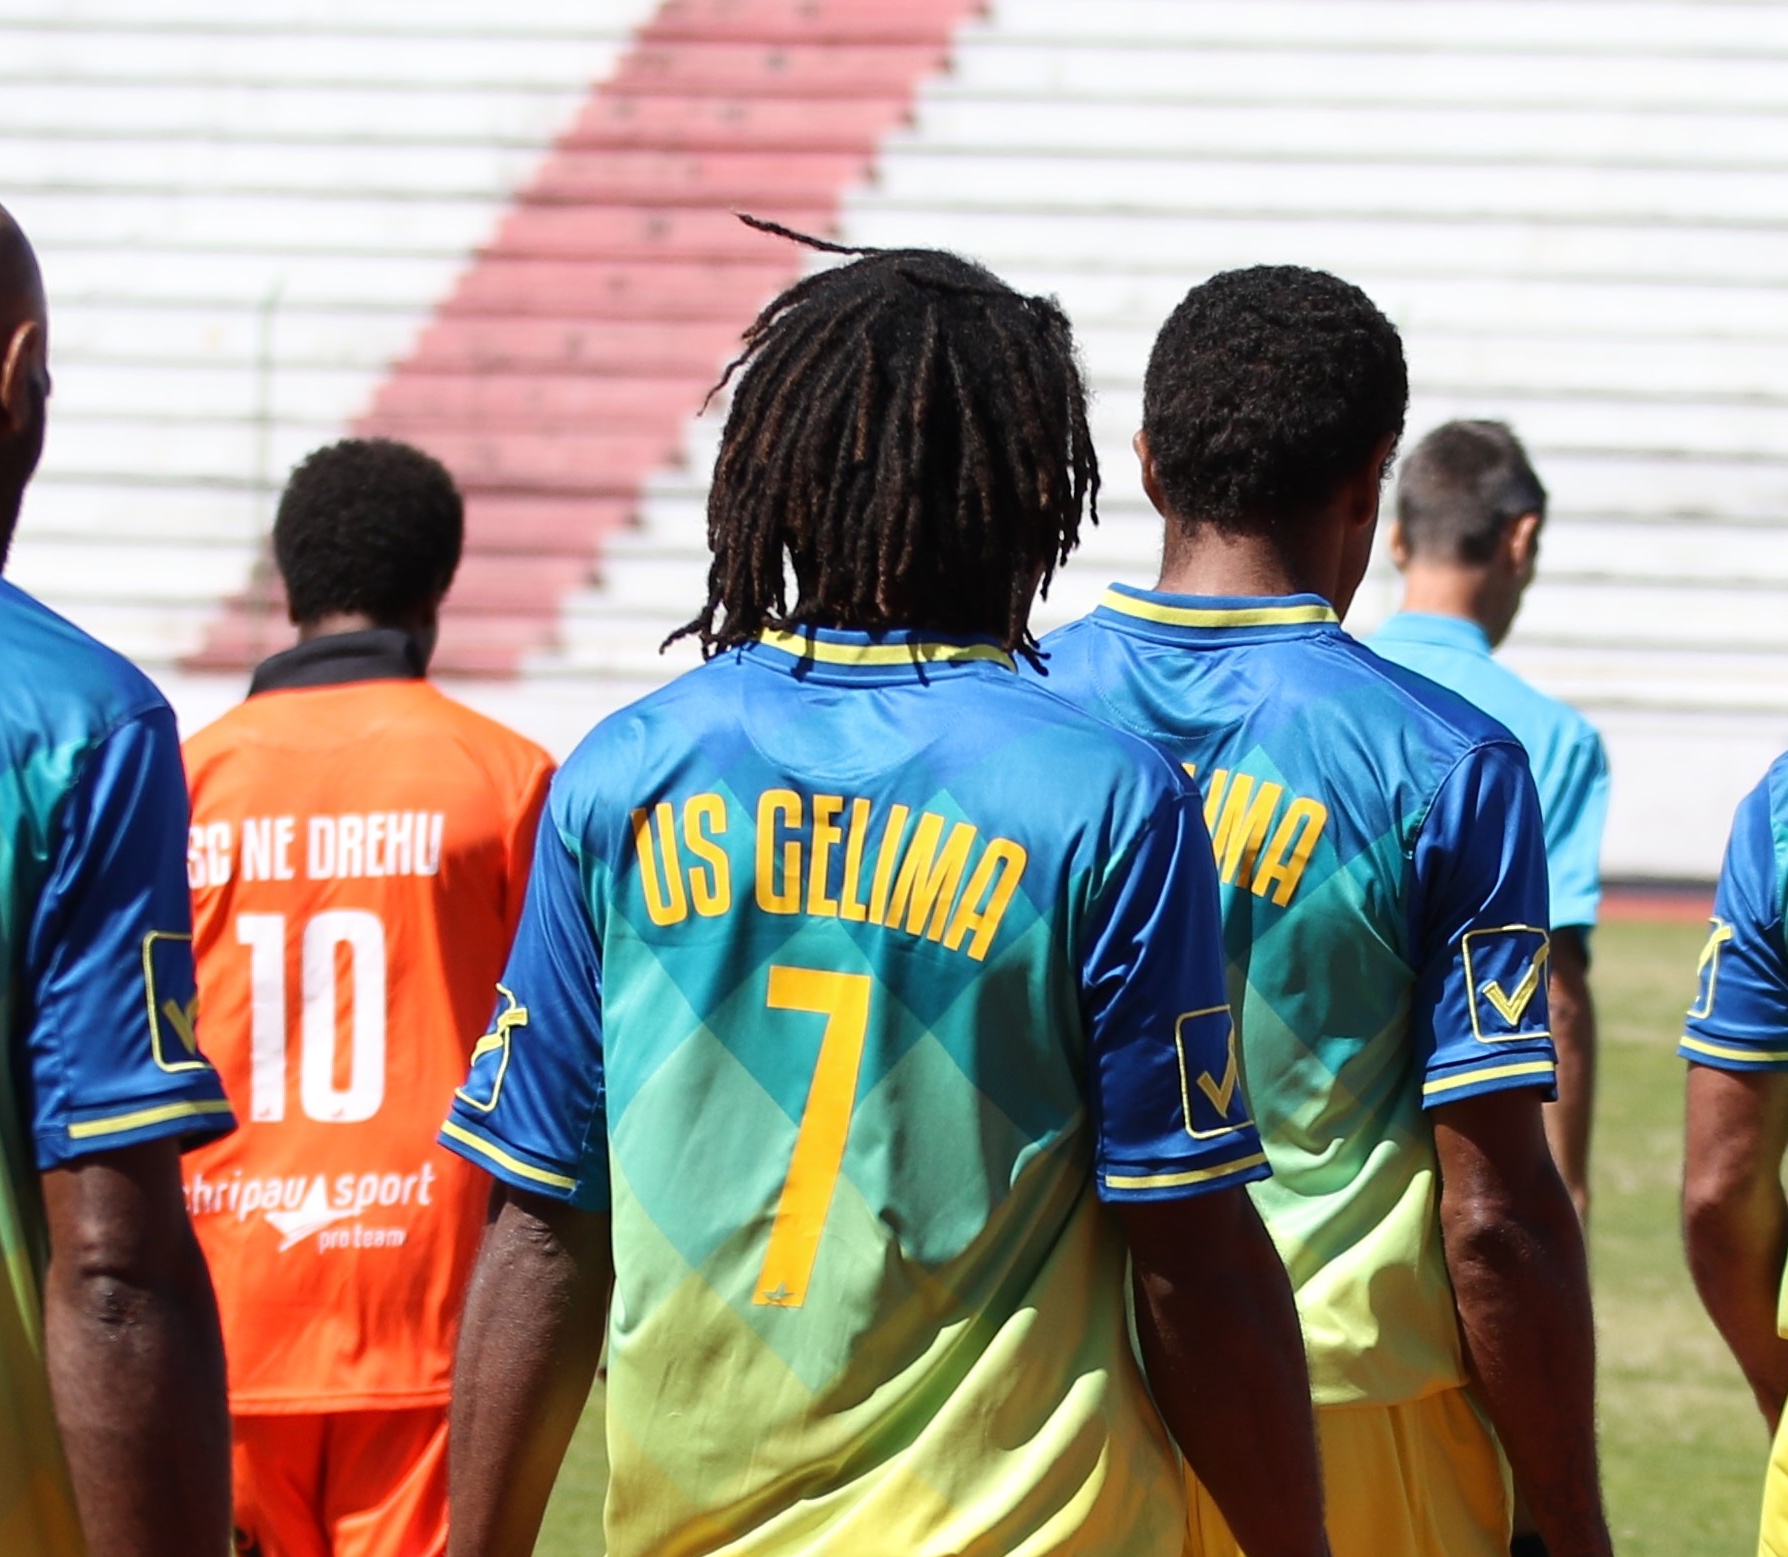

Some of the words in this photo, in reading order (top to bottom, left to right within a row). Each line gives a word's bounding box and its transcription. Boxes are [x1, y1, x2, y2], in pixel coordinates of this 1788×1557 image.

[186, 819, 233, 891] SC
[241, 814, 297, 883] NE
[306, 809, 446, 881] DREHU
[631, 793, 733, 928] US
[753, 788, 1030, 962] GELIMA
[234, 907, 388, 1124] 10
[184, 1168, 308, 1223] hripau
[333, 1161, 437, 1216] sport
[751, 964, 872, 1308] 7
[317, 1230, 351, 1255] pro
[352, 1223, 409, 1249] team
